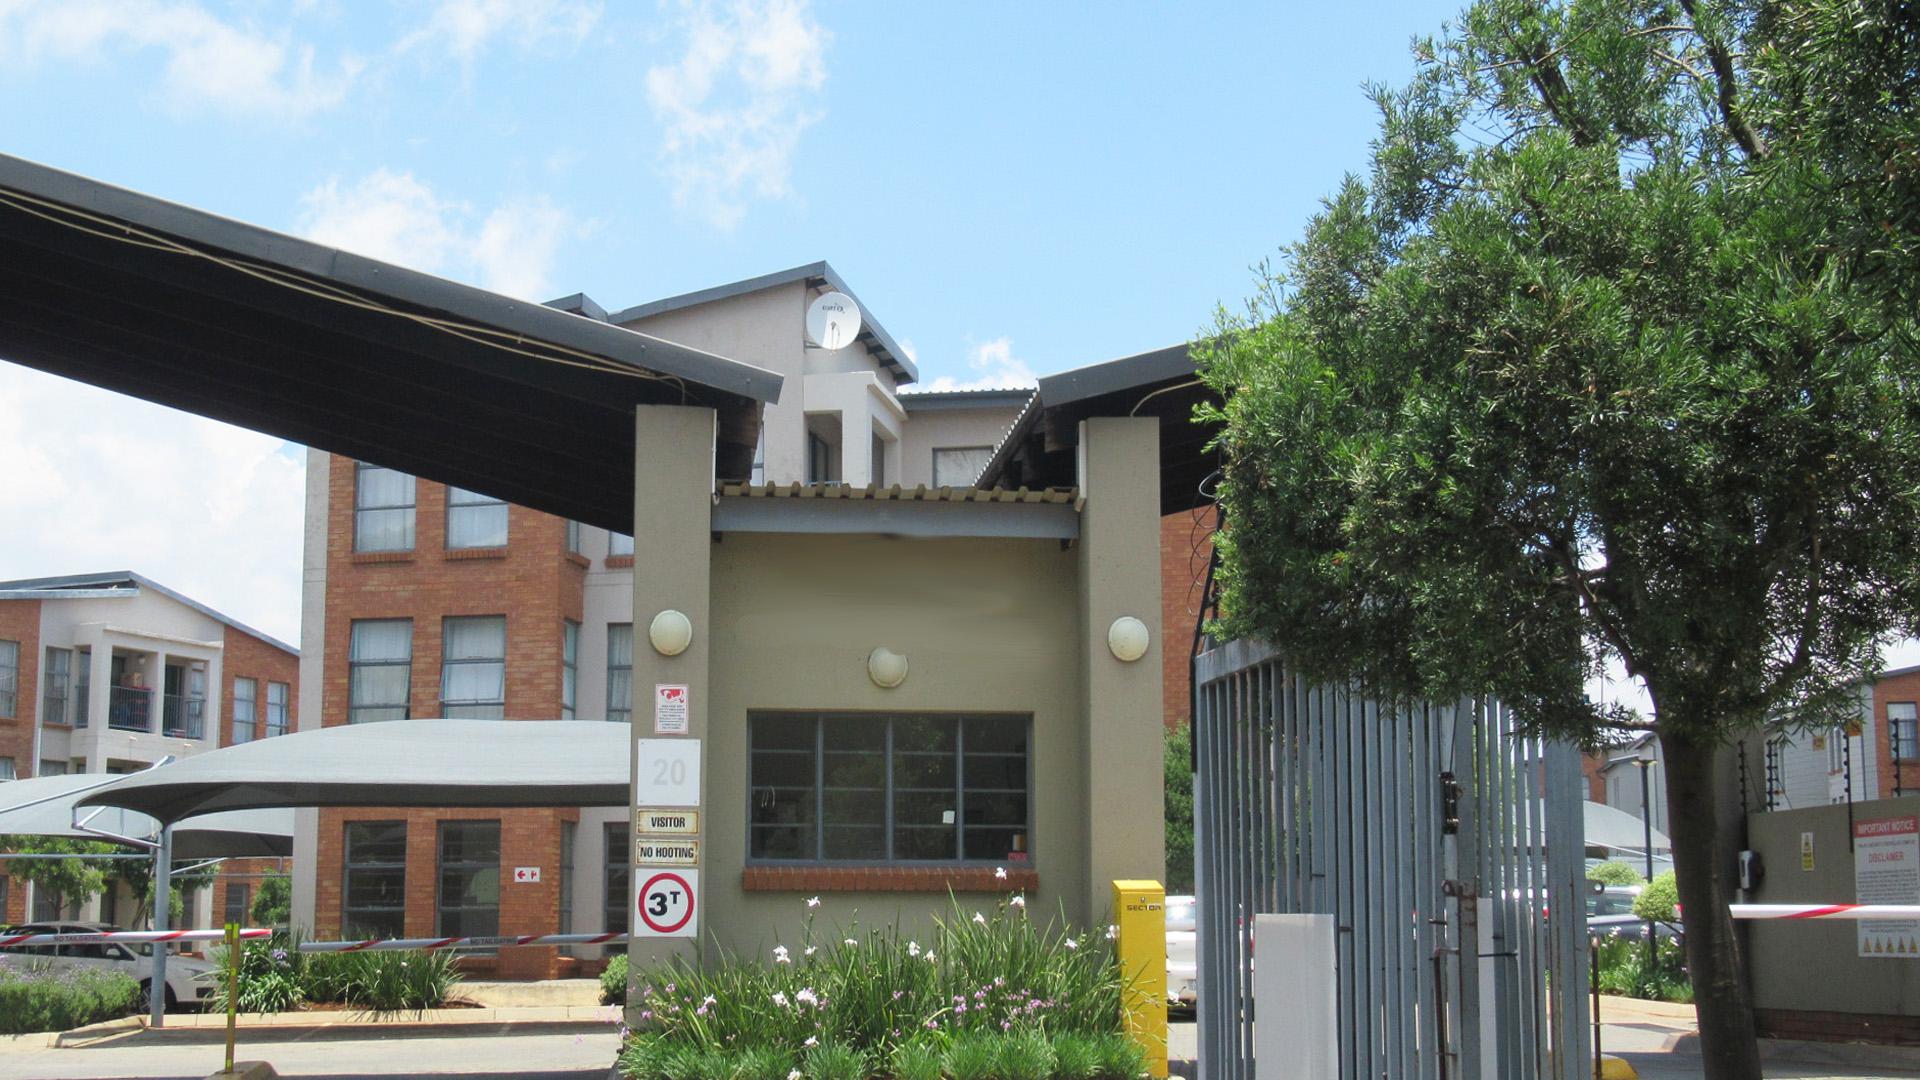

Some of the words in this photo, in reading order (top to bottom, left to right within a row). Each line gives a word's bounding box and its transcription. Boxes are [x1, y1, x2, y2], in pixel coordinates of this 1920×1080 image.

[653, 759, 686, 786] 20
[651, 816, 686, 828] VISITOR
[1858, 822, 1890, 834] IMPORTANT
[1892, 819, 1914, 831] NOTICE
[640, 846, 653, 858] NO
[655, 847, 694, 858] HOOTING
